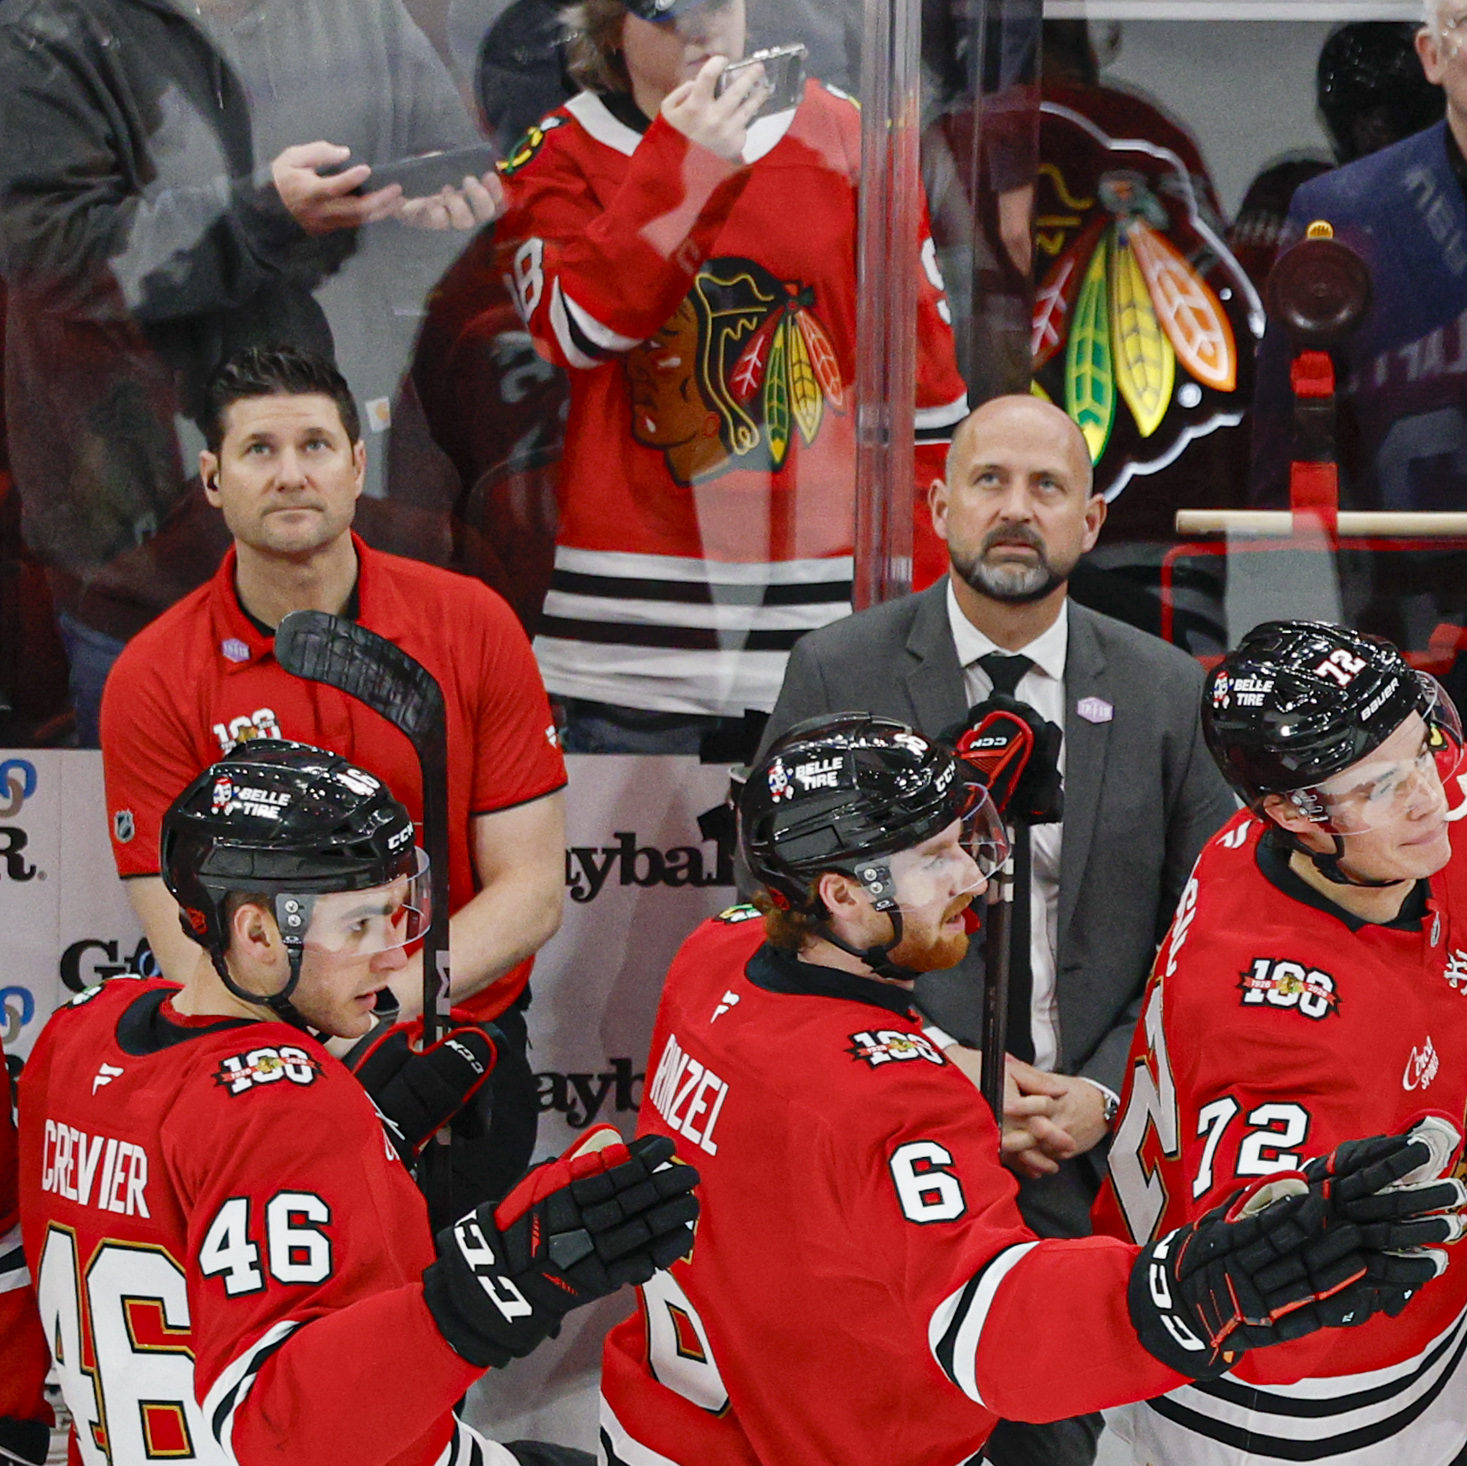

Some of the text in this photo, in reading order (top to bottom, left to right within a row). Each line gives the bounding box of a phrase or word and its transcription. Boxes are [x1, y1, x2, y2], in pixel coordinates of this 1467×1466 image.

[1234, 678, 1274, 694] BELLE
[1314, 648, 1368, 689] 72
[1236, 693, 1265, 707] TIRE
[796, 757, 844, 780] BELLE
[802, 771, 839, 793] TIRE
[239, 787, 292, 807] BELLE
[242, 802, 283, 819] TIRE
[1243, 958, 1335, 1020] 100
[222, 1046, 314, 1094] 100
[649, 1033, 731, 1157] RINZEL
[41, 1118, 151, 1220] CREVIER
[1190, 1095, 1310, 1200] 72
[889, 1138, 968, 1225] 6
[198, 1189, 333, 1297] 46
